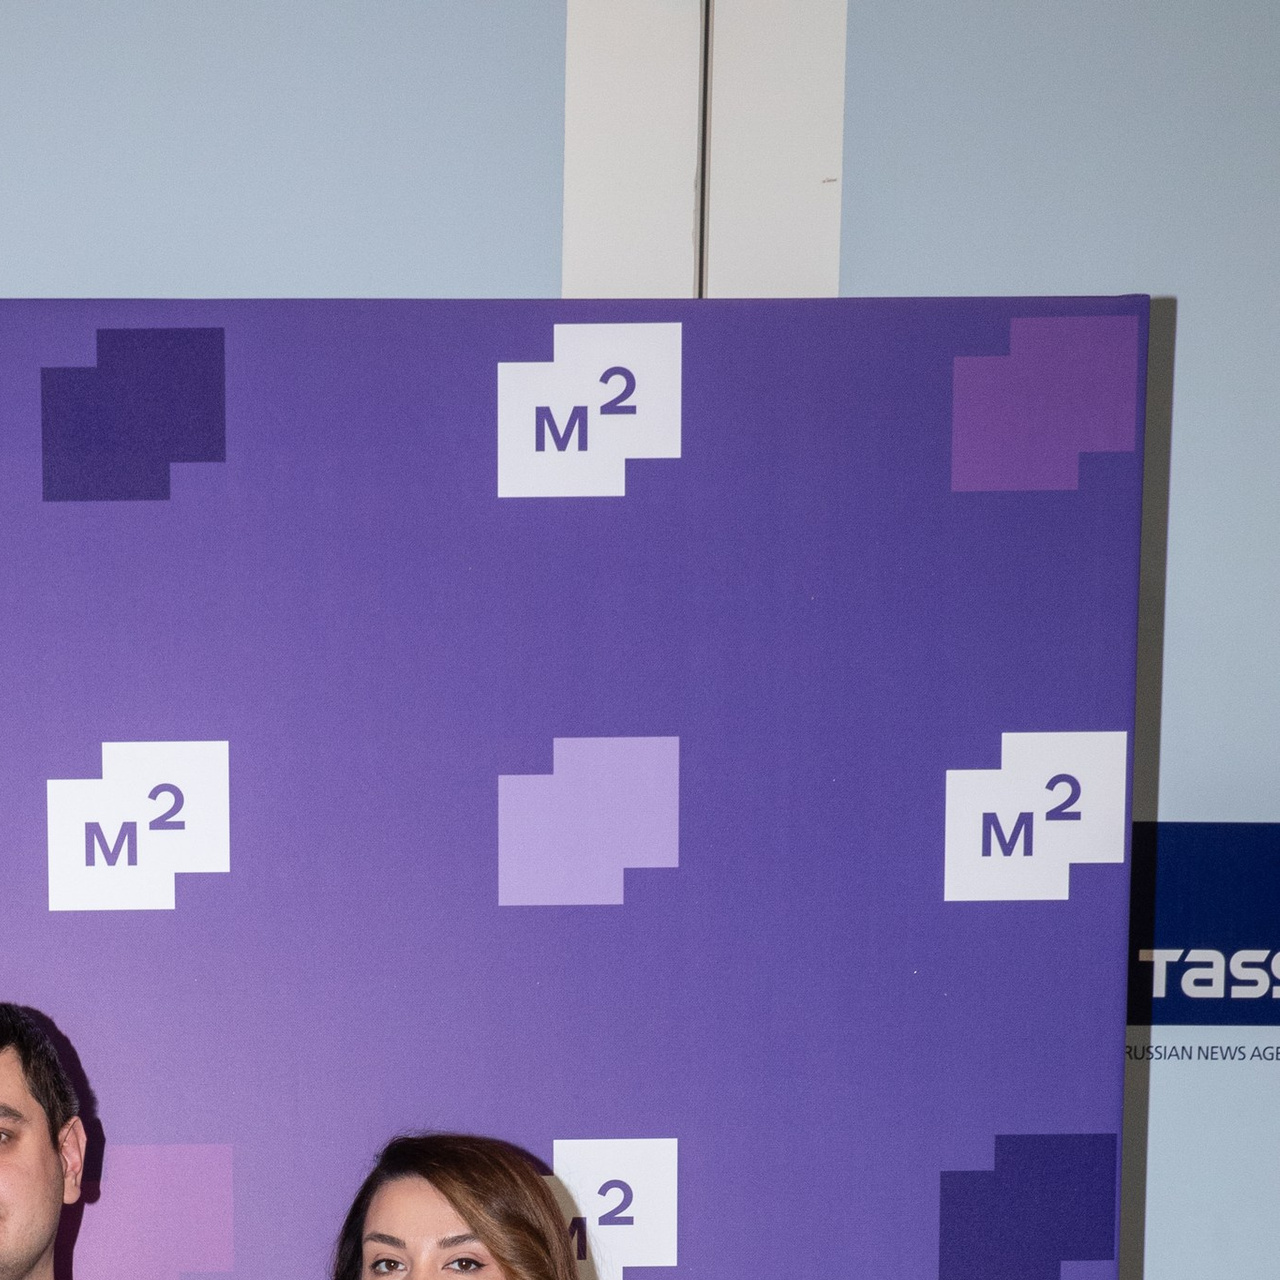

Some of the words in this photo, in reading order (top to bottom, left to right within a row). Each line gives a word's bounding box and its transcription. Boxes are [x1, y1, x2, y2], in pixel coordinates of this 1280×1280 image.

[1139, 949, 1280, 998] Tas
[1125, 1045, 1193, 1061] RUSSIAN
[1198, 1045, 1246, 1061] NEWS
